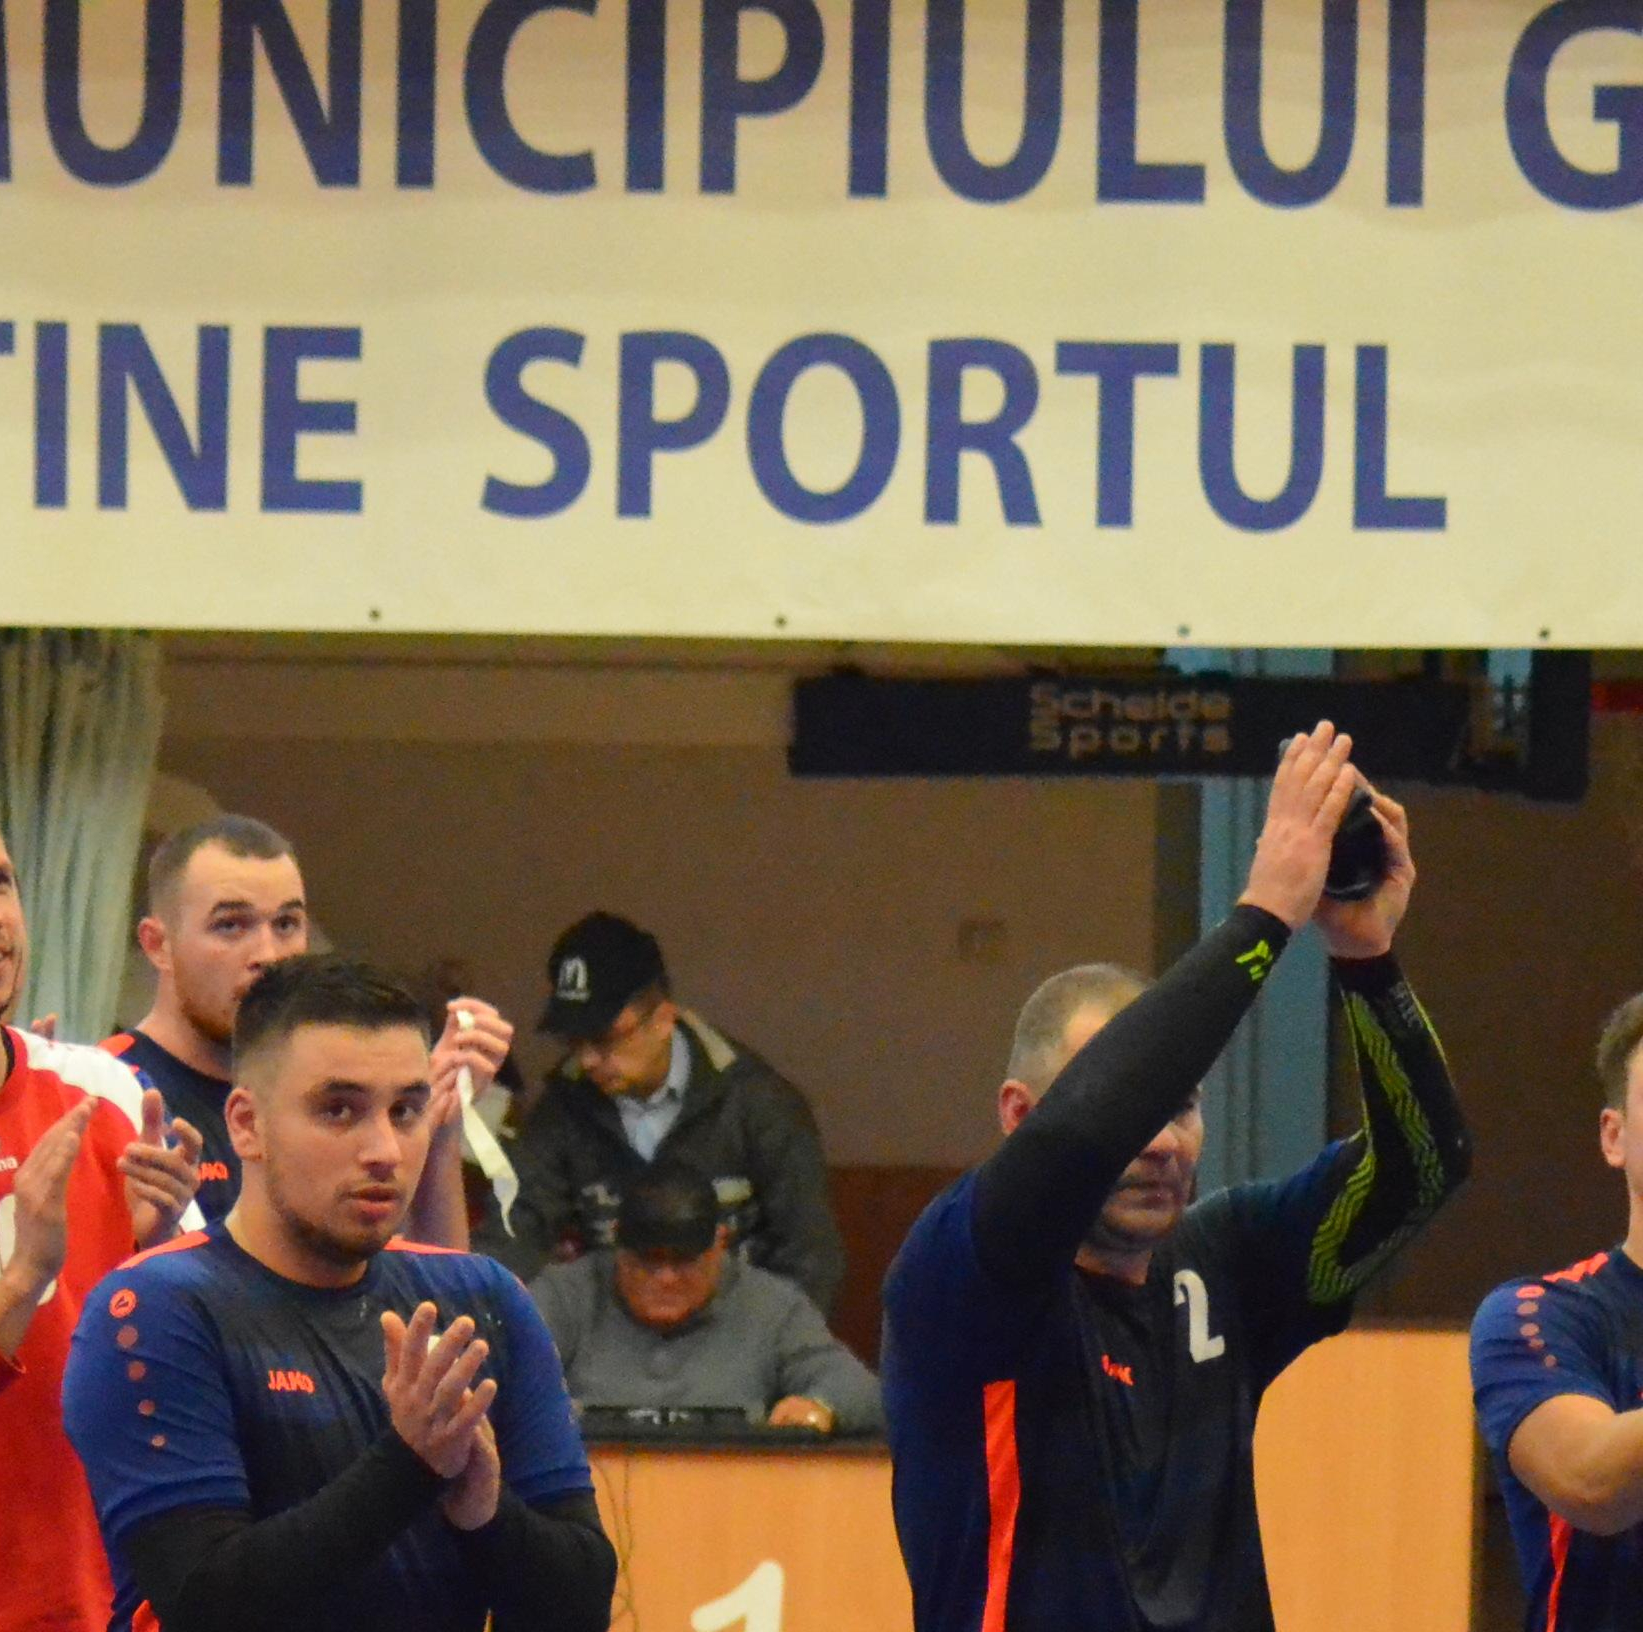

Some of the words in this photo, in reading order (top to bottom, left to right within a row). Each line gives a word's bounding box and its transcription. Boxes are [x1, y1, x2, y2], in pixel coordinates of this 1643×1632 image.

[1504, 0, 1643, 209] G
[480, 326, 1447, 533] SPORTUL
[1029, 718, 1232, 759] Sports
[267, 1368, 316, 1393] JAKO
